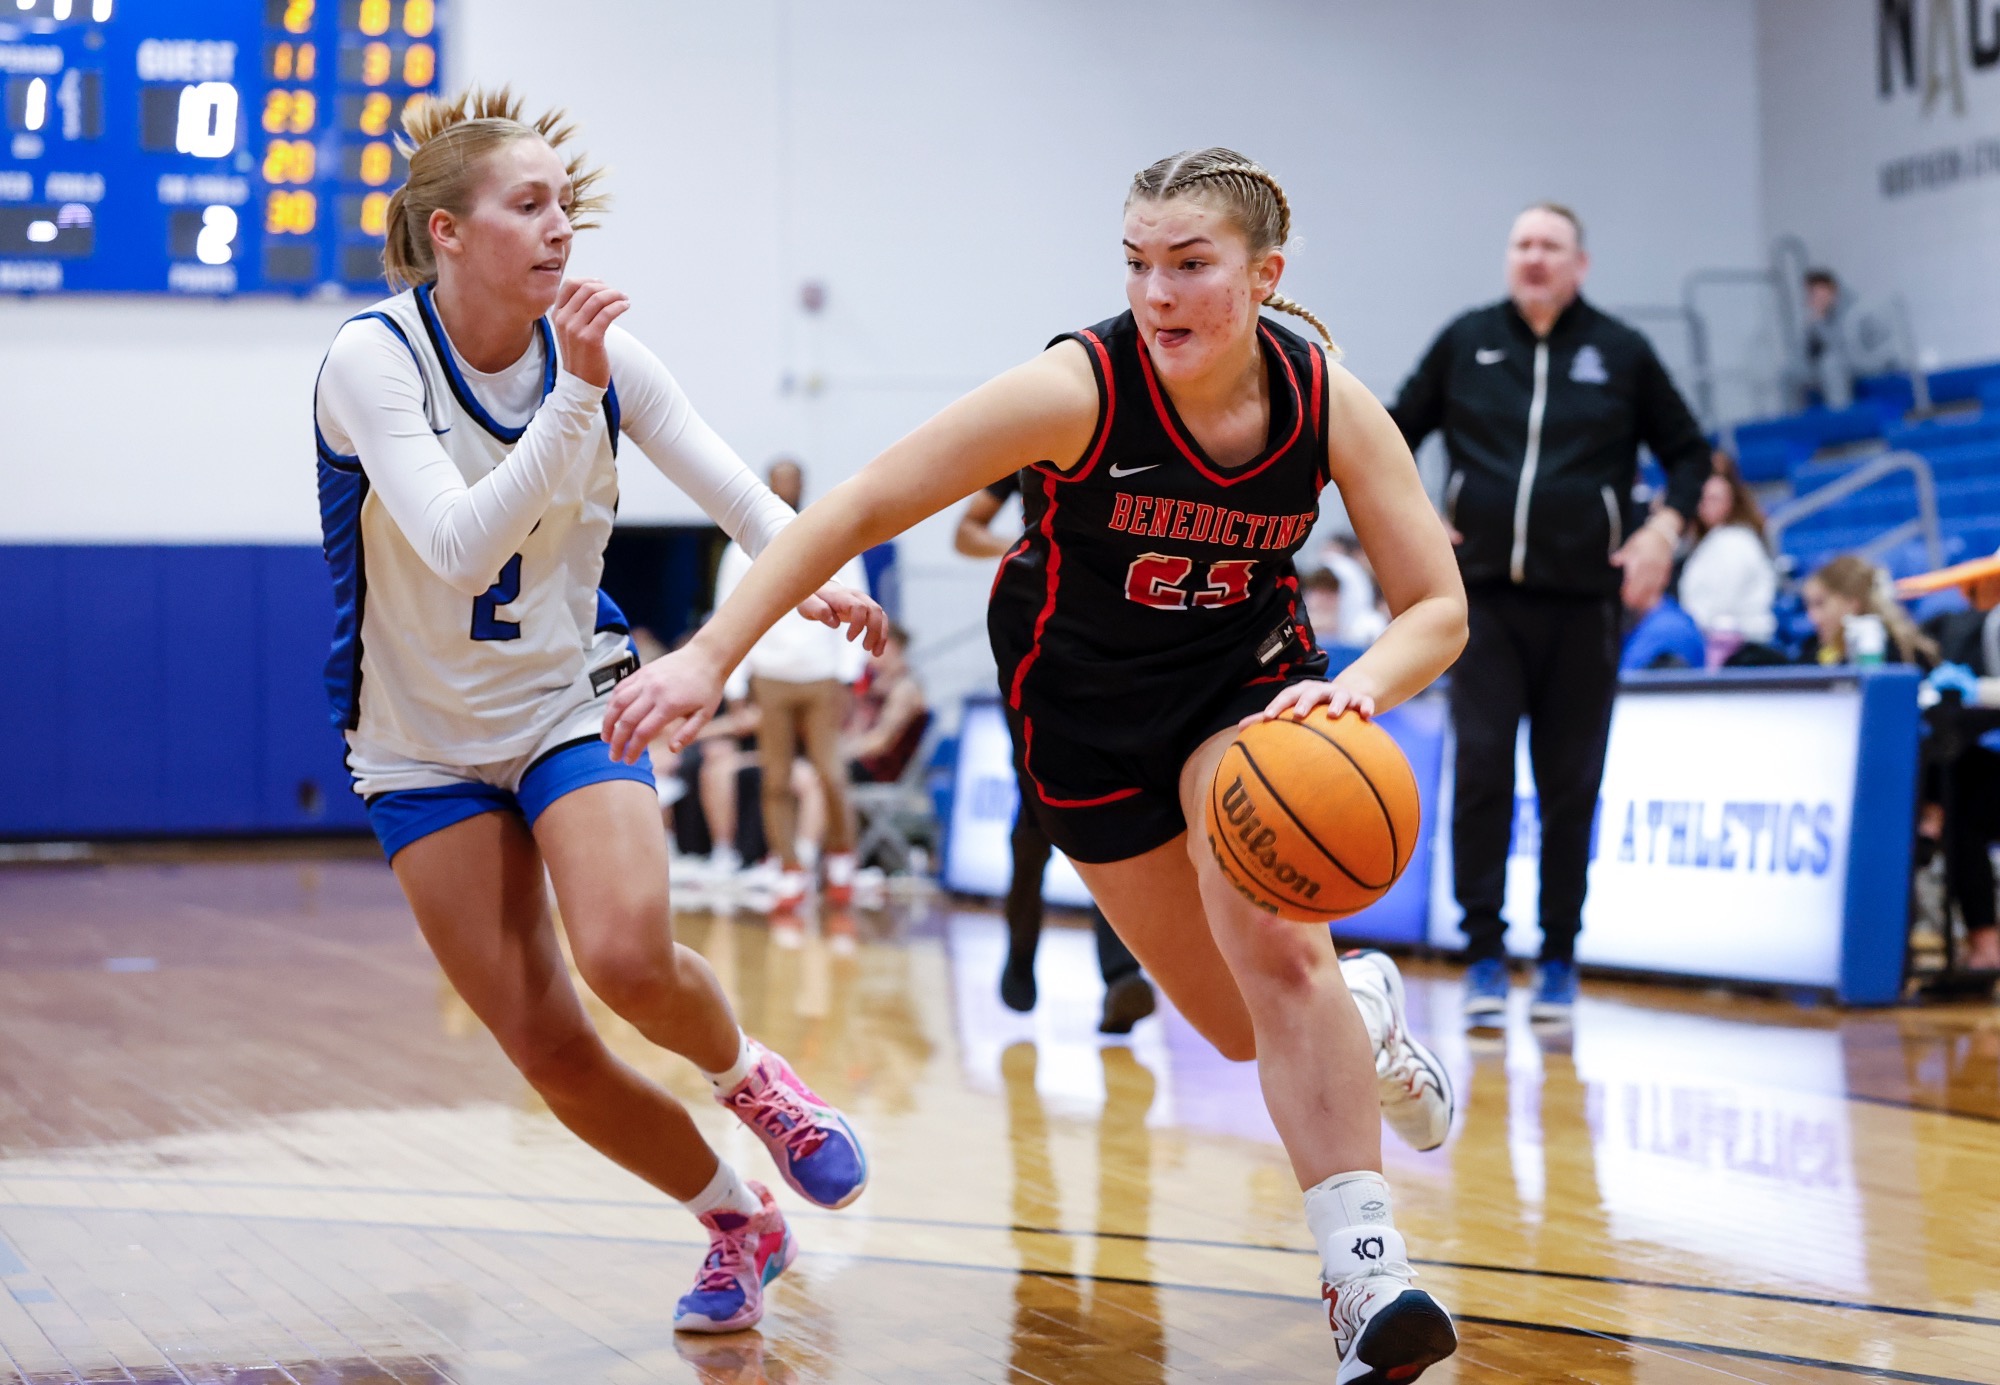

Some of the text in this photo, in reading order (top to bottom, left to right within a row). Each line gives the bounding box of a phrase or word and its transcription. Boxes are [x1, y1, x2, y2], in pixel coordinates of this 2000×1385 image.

[176, 82, 238, 158] 10
[197, 205, 238, 265] 2
[1108, 492, 1315, 550] BENEDICTINE
[470, 551, 522, 641] 2
[1222, 776, 1321, 899] Wilson
[1617, 799, 1833, 877] ATHLETICS
